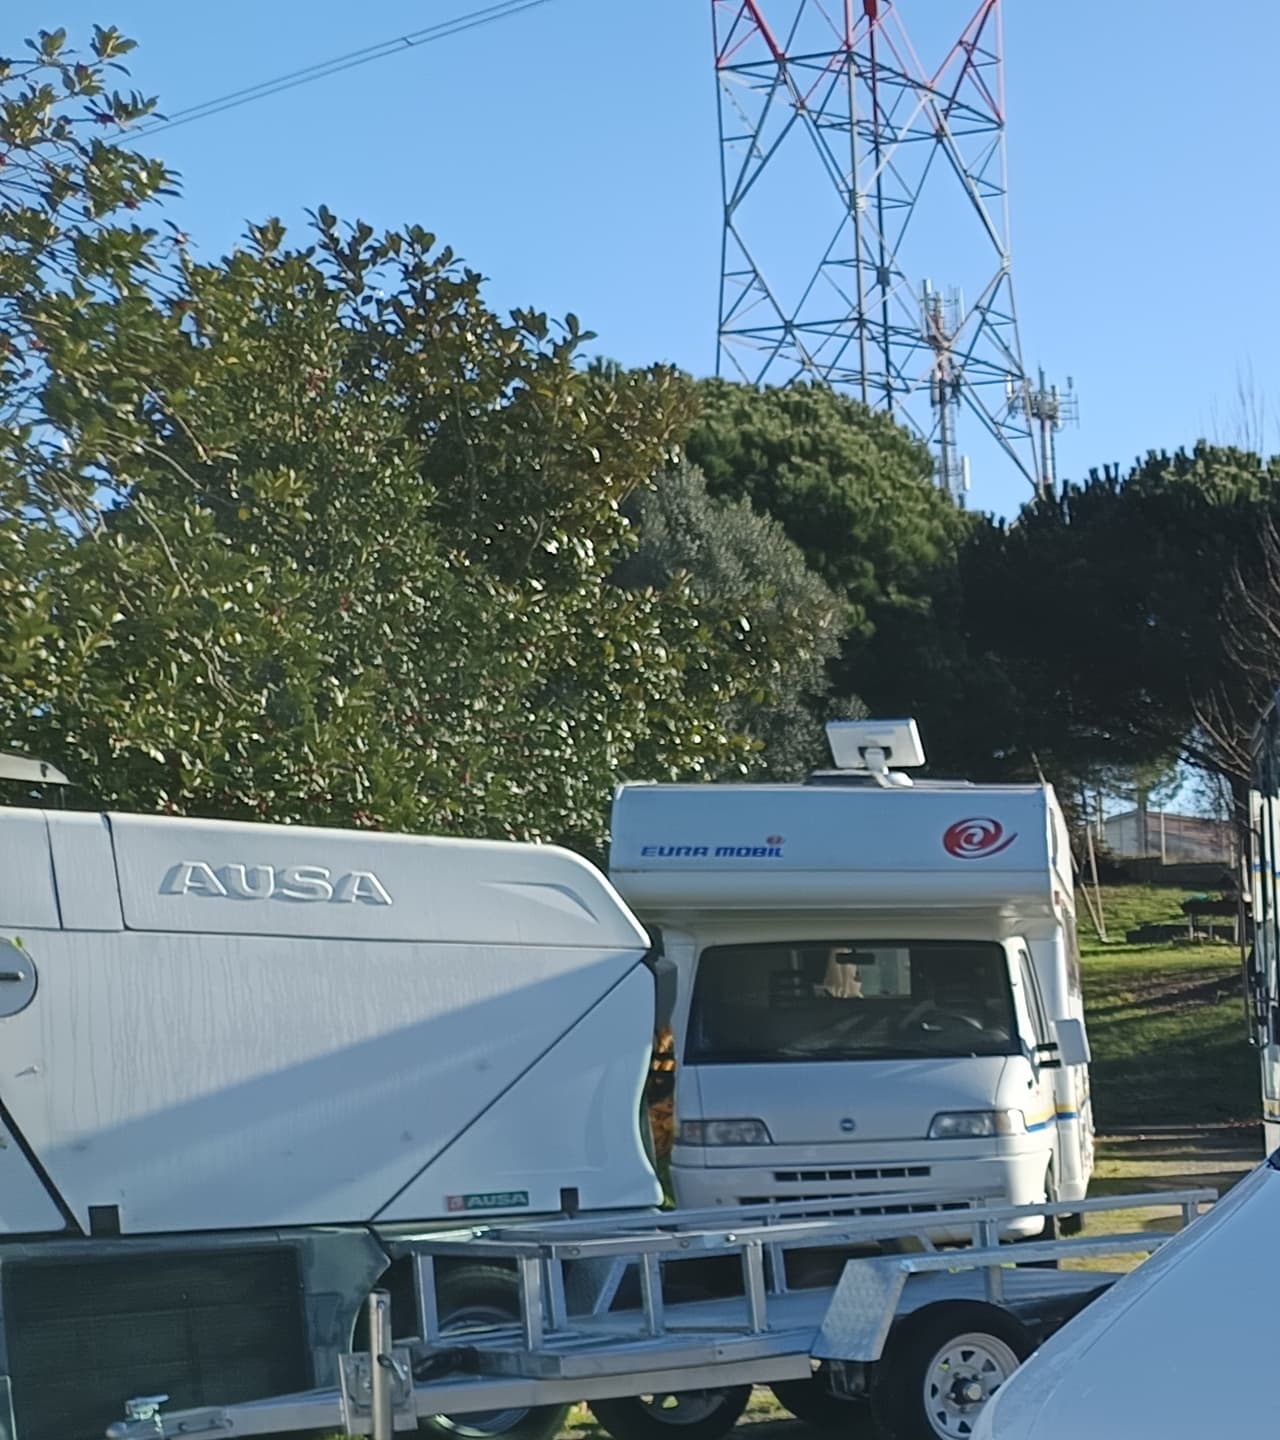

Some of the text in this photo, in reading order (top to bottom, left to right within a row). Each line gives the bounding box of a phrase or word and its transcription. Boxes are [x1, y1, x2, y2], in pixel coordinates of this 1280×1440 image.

[641, 846, 784, 858] EURA MOBIL
[162, 860, 393, 905] AUSA
[467, 1194, 527, 1208] AUSA
